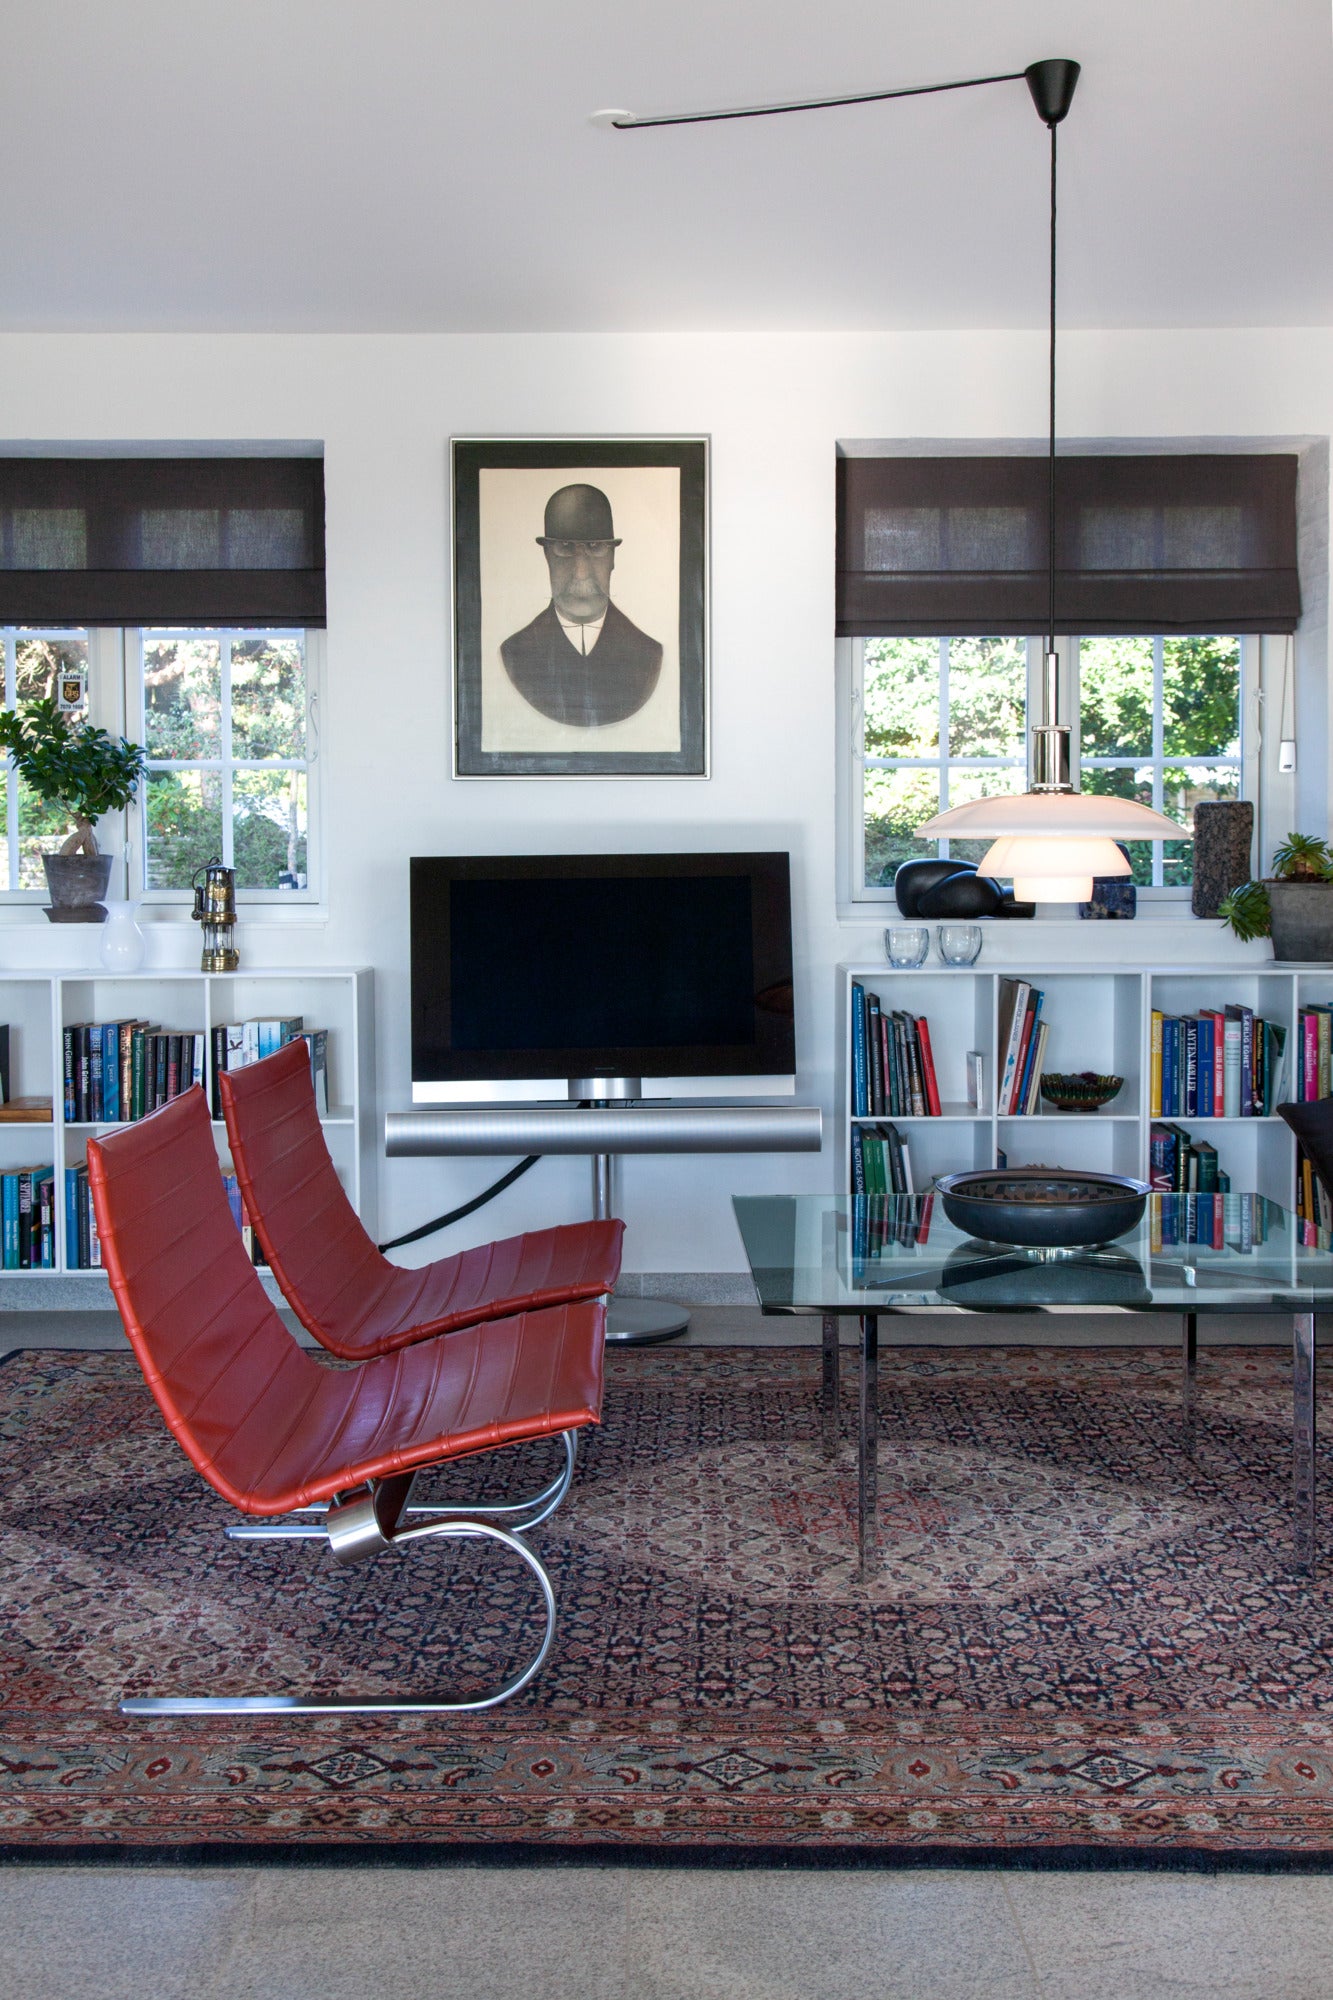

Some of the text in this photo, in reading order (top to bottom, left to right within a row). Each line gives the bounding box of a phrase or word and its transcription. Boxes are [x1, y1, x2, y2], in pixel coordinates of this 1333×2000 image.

[64, 1033, 73, 1078] JOHN GRISHAM
[92, 1030, 101, 1051] ROBERT
[81, 1056, 89, 1094] John Grisham
[92, 1053, 101, 1079] GODDARD
[1187, 1028, 1196, 1092] MYTEN MØLLER
[854, 1148, 862, 1174] RIGTIGE
[20, 1182, 30, 1213] SEPTEMBER
